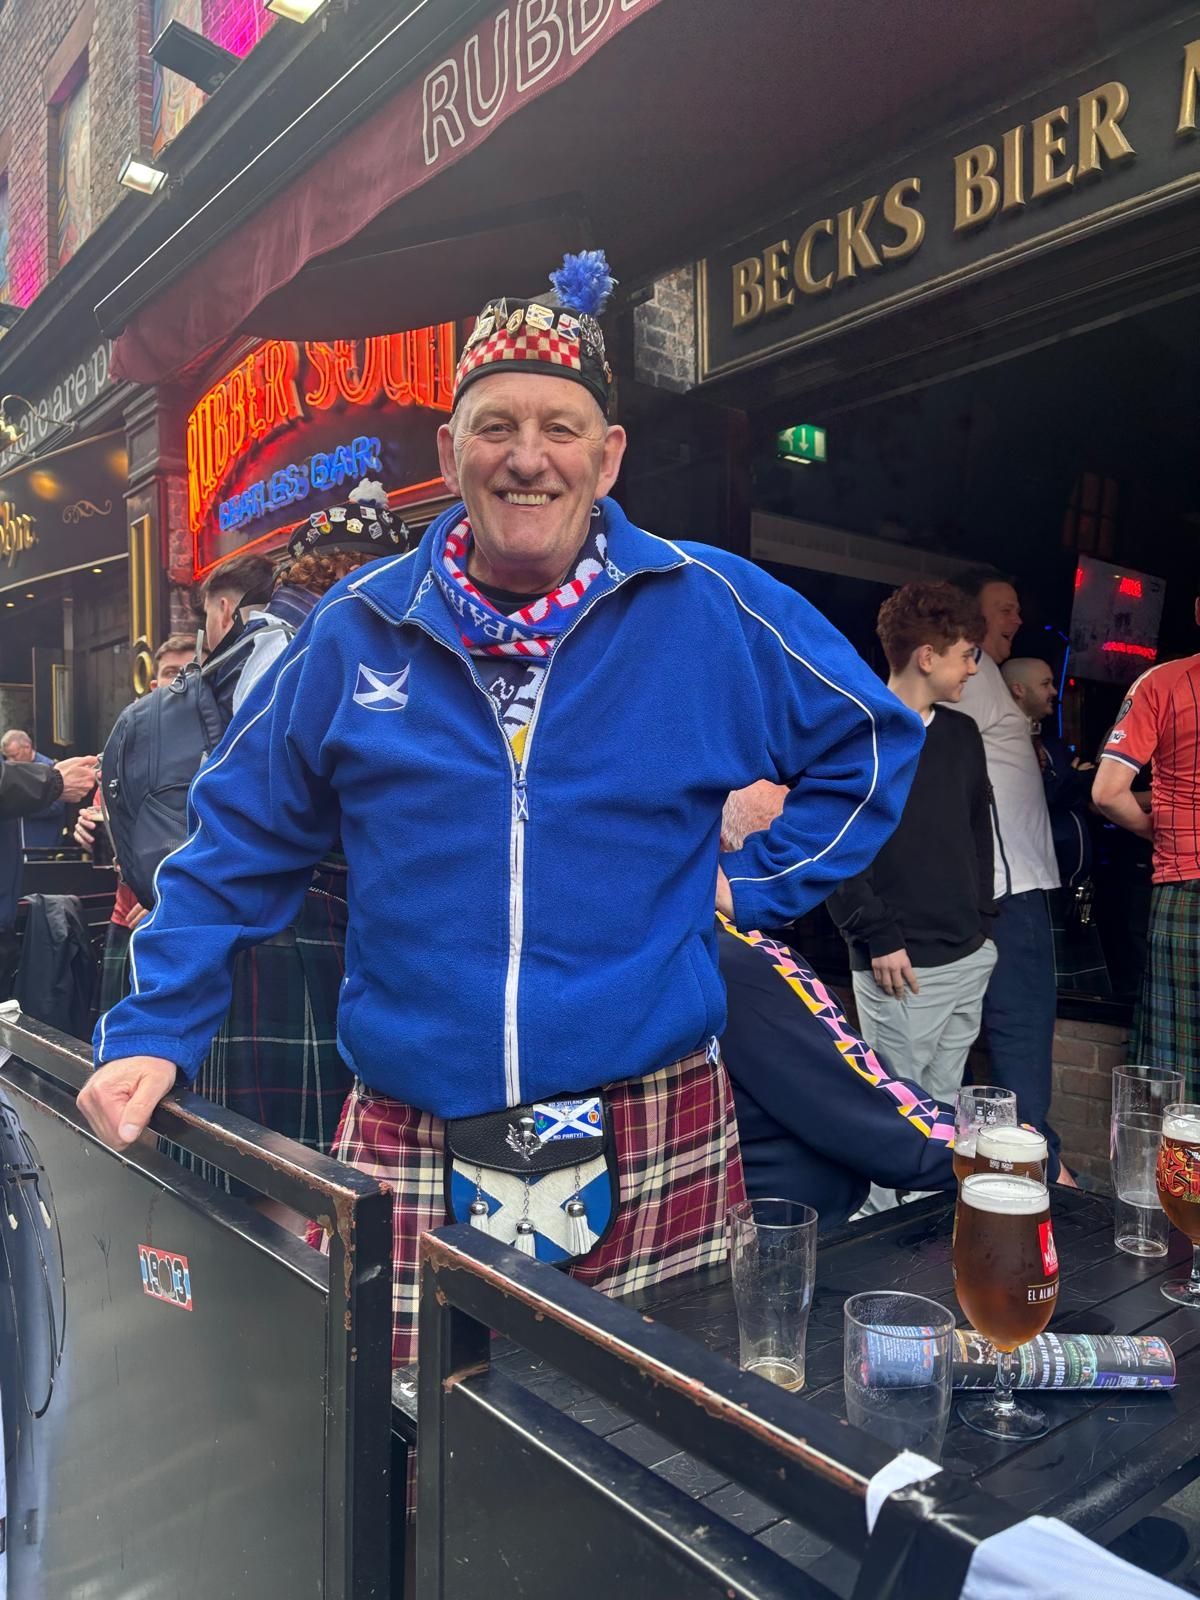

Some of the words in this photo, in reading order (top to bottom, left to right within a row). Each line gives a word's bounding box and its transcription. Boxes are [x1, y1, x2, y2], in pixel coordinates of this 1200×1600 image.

[423, 0, 641, 165] RUBB
[732, 176, 926, 328] BECKS
[953, 81, 1137, 232] BIER
[187, 339, 300, 532] RUBBER
[219, 463, 304, 532] BEATLES
[310, 436, 380, 490] BAR
[1028, 1289, 1037, 1302] EL
[1053, 1356, 1066, 1386] BIGGEST
